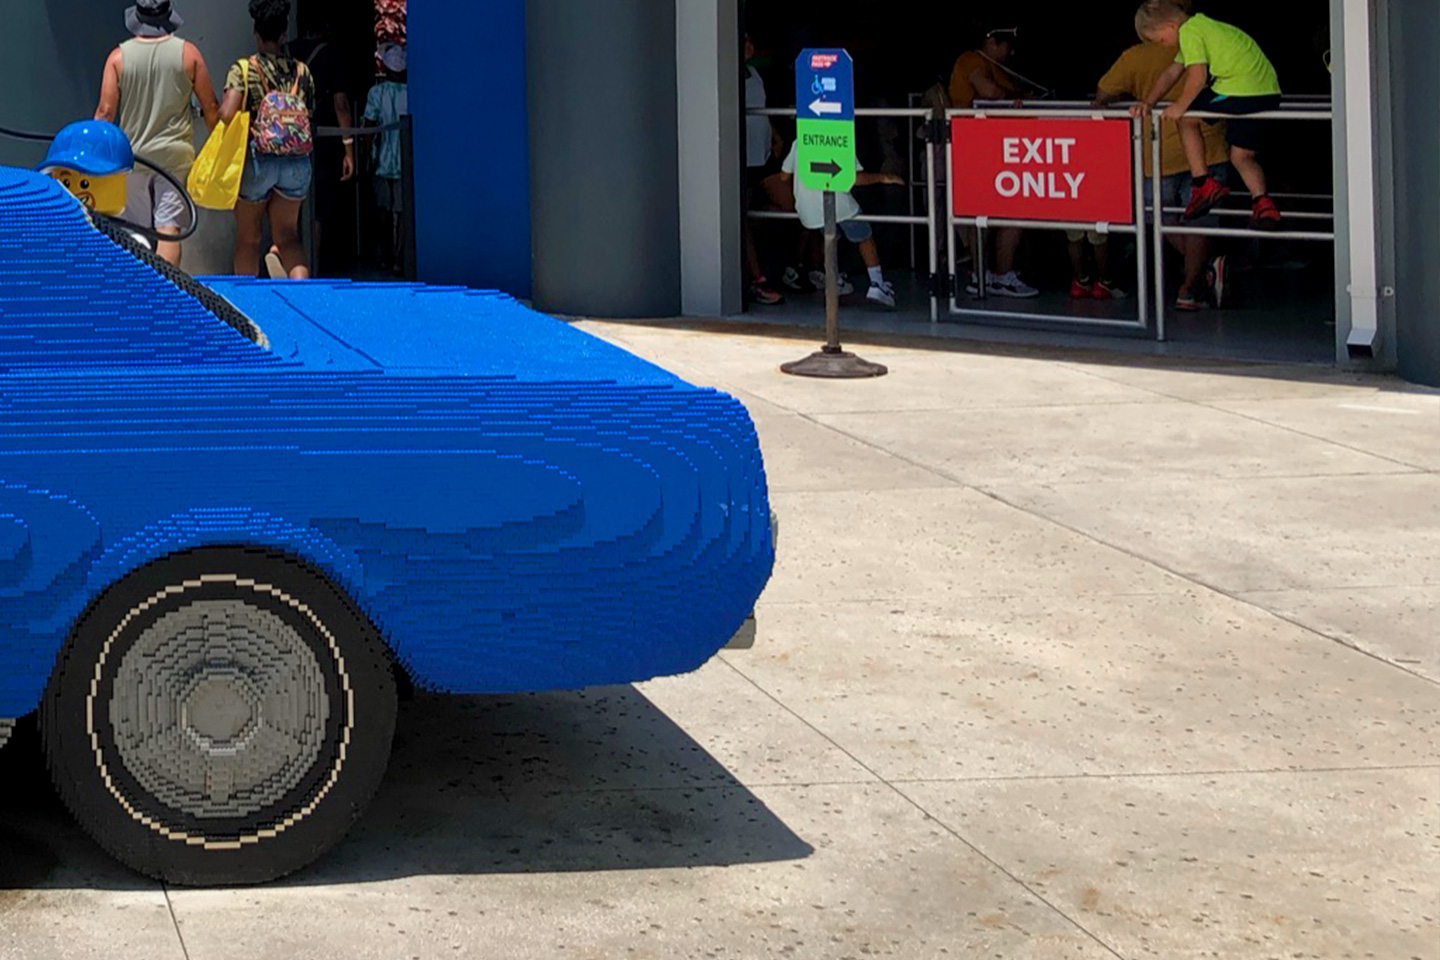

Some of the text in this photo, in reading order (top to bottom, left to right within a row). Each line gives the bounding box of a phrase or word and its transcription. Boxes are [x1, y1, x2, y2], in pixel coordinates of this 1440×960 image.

[802, 133, 848, 148] ENTRANCE
[1002, 137, 1076, 165] EXIT
[994, 171, 1085, 199] ONLY
